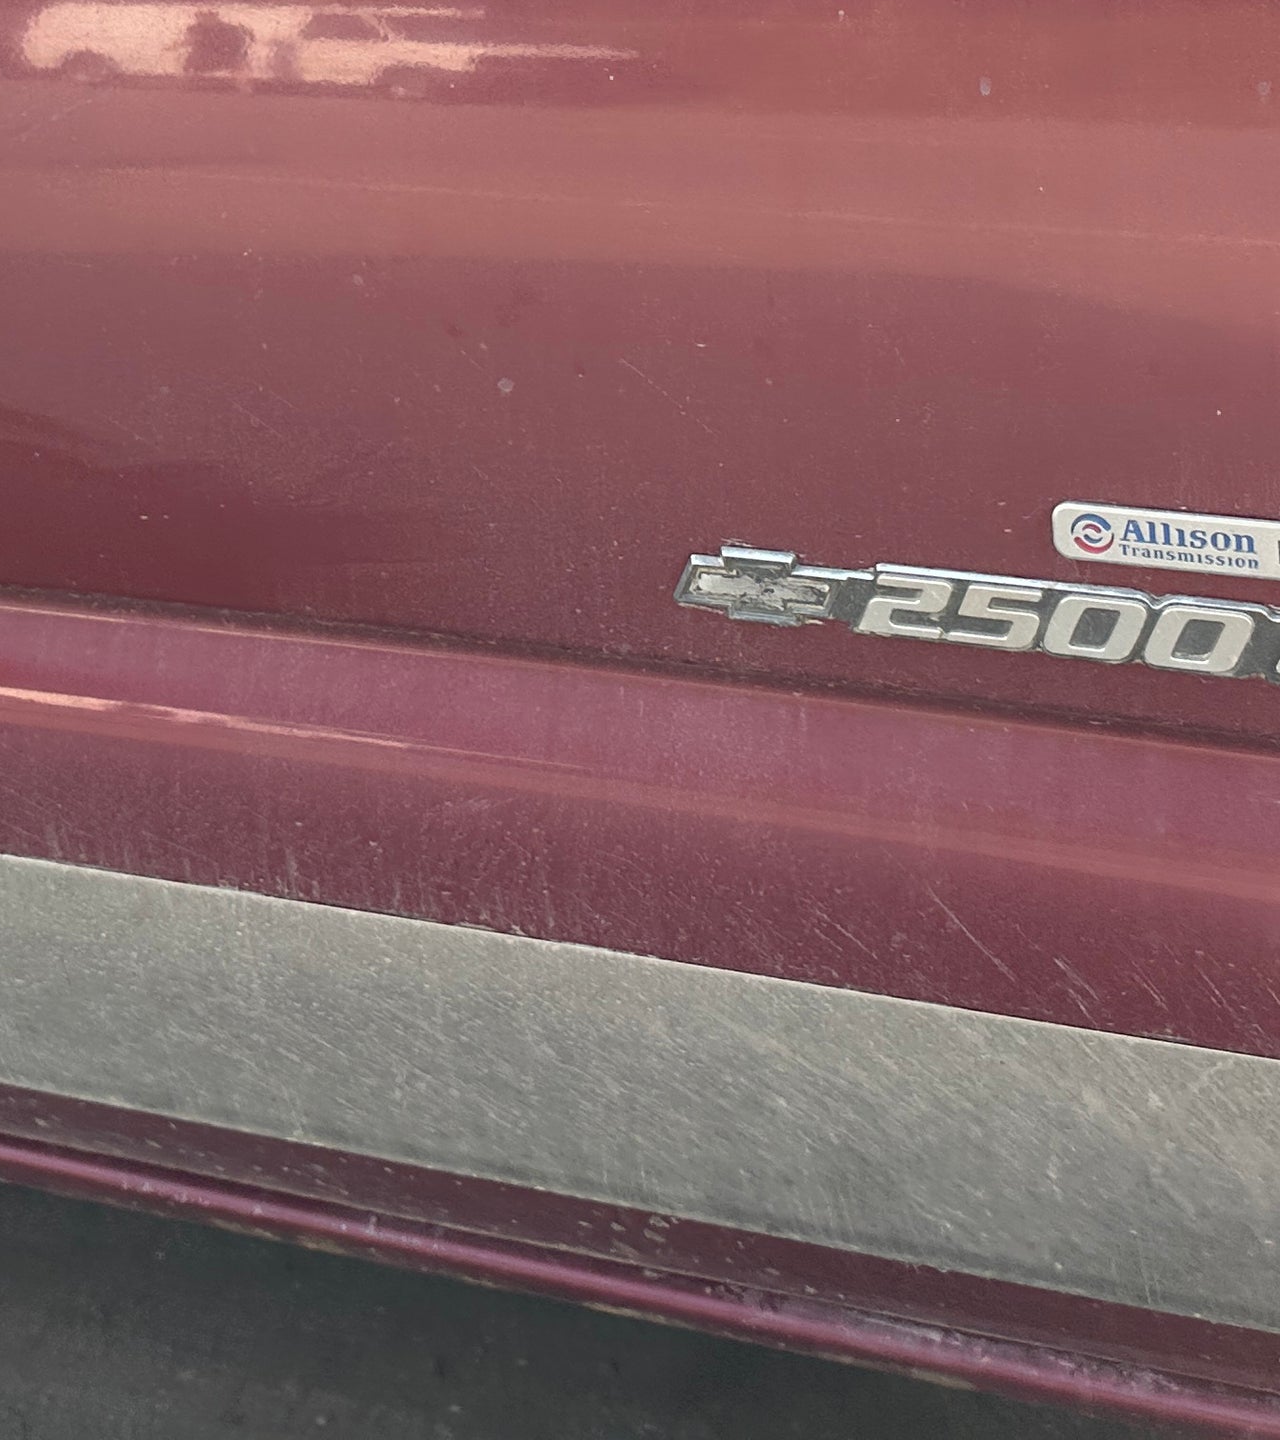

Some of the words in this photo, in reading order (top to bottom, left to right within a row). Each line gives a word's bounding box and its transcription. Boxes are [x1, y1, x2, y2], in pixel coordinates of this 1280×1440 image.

[1119, 519, 1257, 555] Allison
[1119, 543, 1260, 569] Transmission
[855, 572, 1255, 672] 2500
